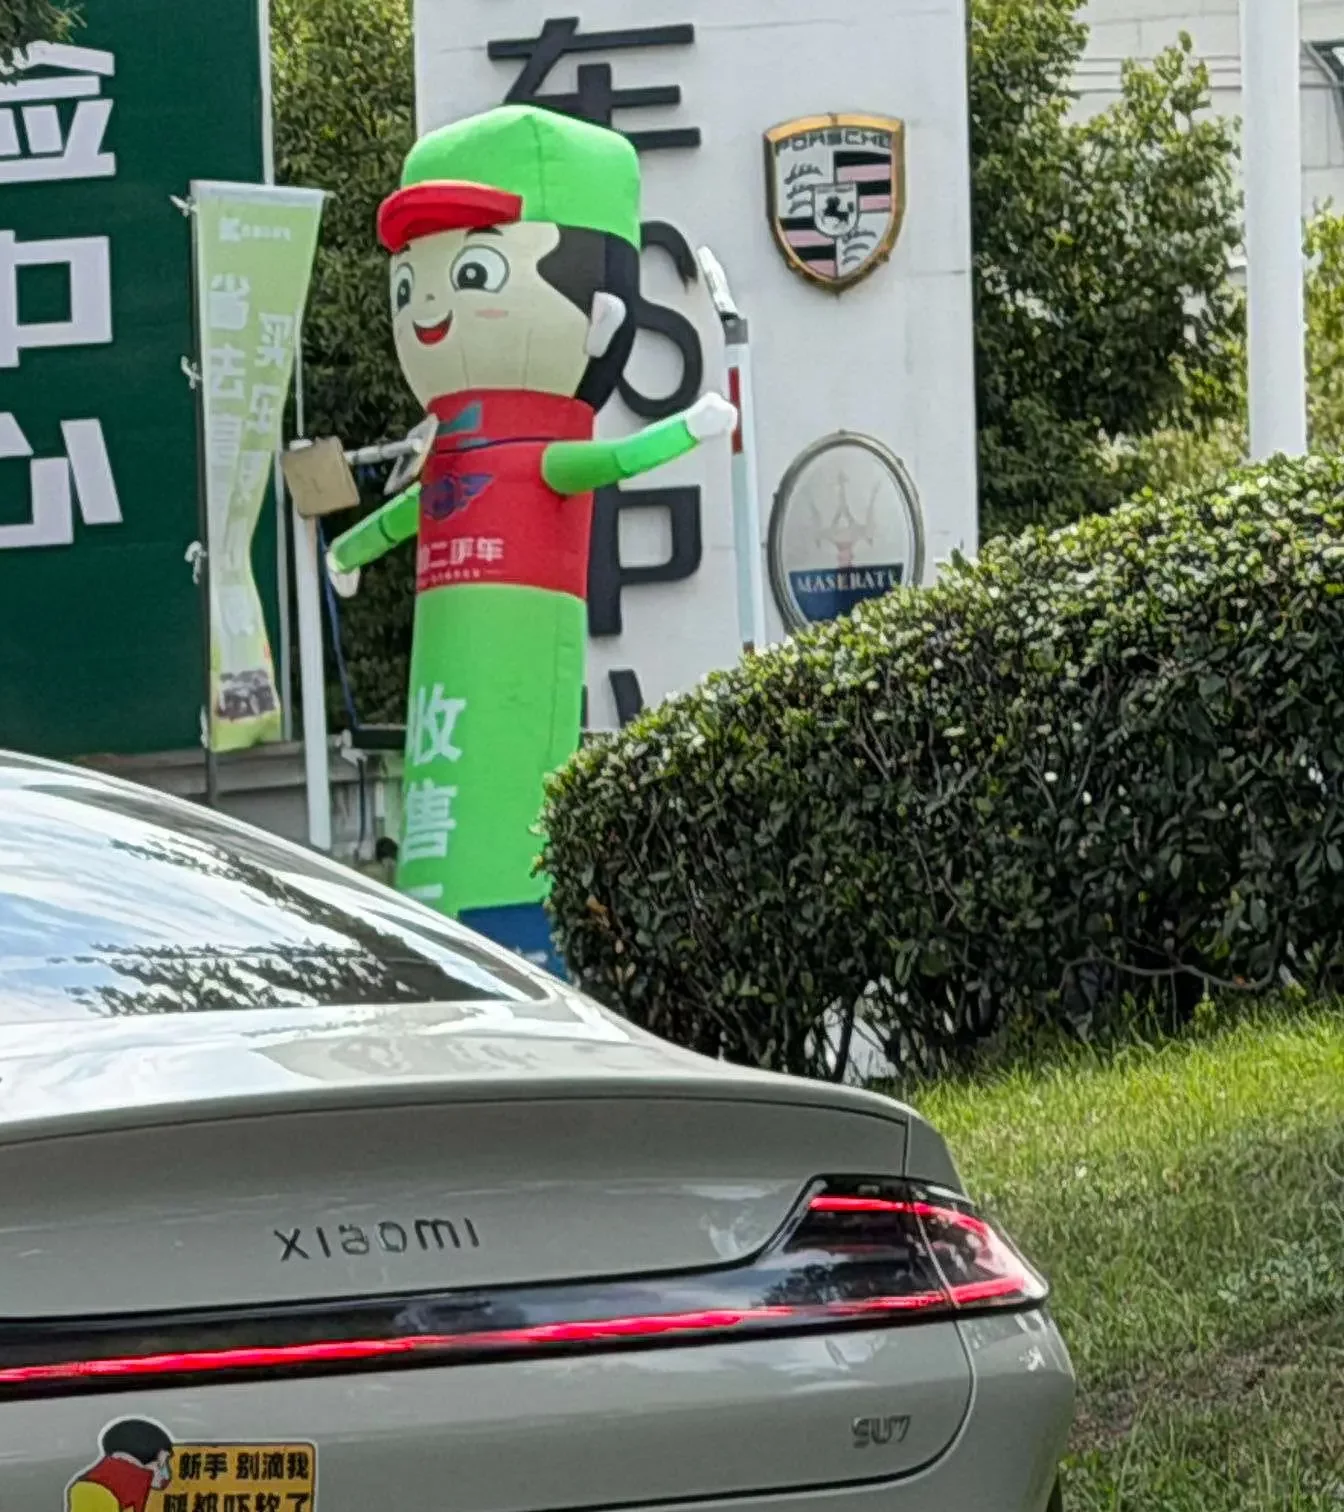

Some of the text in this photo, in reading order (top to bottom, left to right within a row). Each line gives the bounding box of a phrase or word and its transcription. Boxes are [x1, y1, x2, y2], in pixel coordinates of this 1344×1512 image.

[852, 1414, 911, 1449] SU7
[178, 1451, 310, 1481] 新手 别滴我
